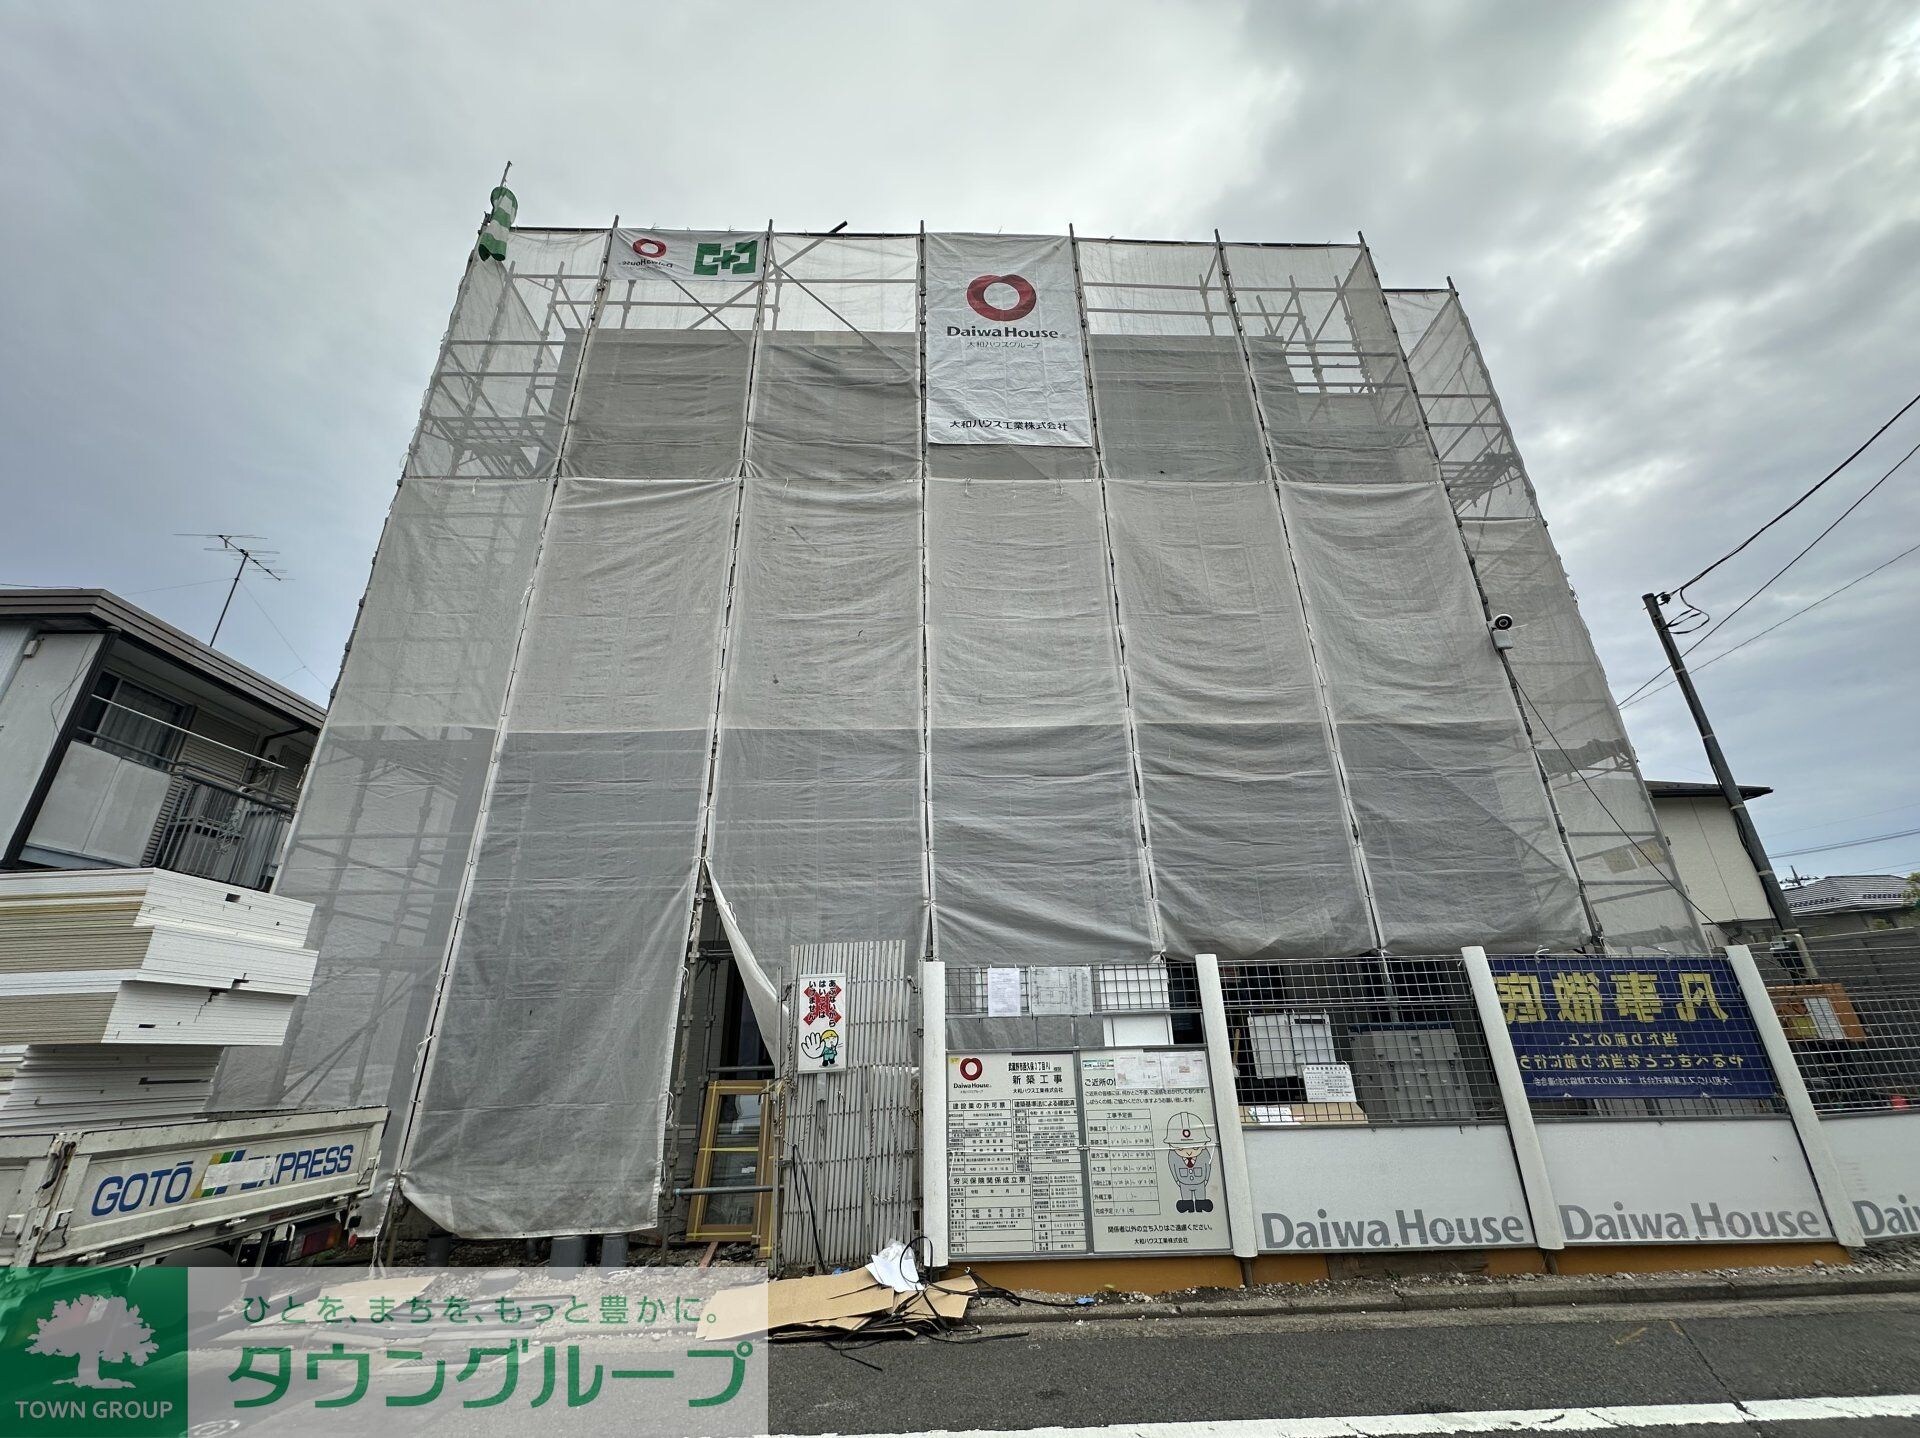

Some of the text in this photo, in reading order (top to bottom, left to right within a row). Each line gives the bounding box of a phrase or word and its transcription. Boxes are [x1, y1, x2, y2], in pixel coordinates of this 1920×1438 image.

[967, 341, 1041, 349] 大和ハウスグループ
[949, 419, 1068, 431] 大和ハウス工業株式会社
[808, 980, 817, 1023] いけません
[818, 979, 827, 1019] はいっては
[828, 979, 837, 1028] あぶないから
[1012, 1074, 1063, 1085] 新築工事
[1084, 1078, 1117, 1087] ご近所の
[953, 1176, 1026, 1184] 労災保険関係成立票
